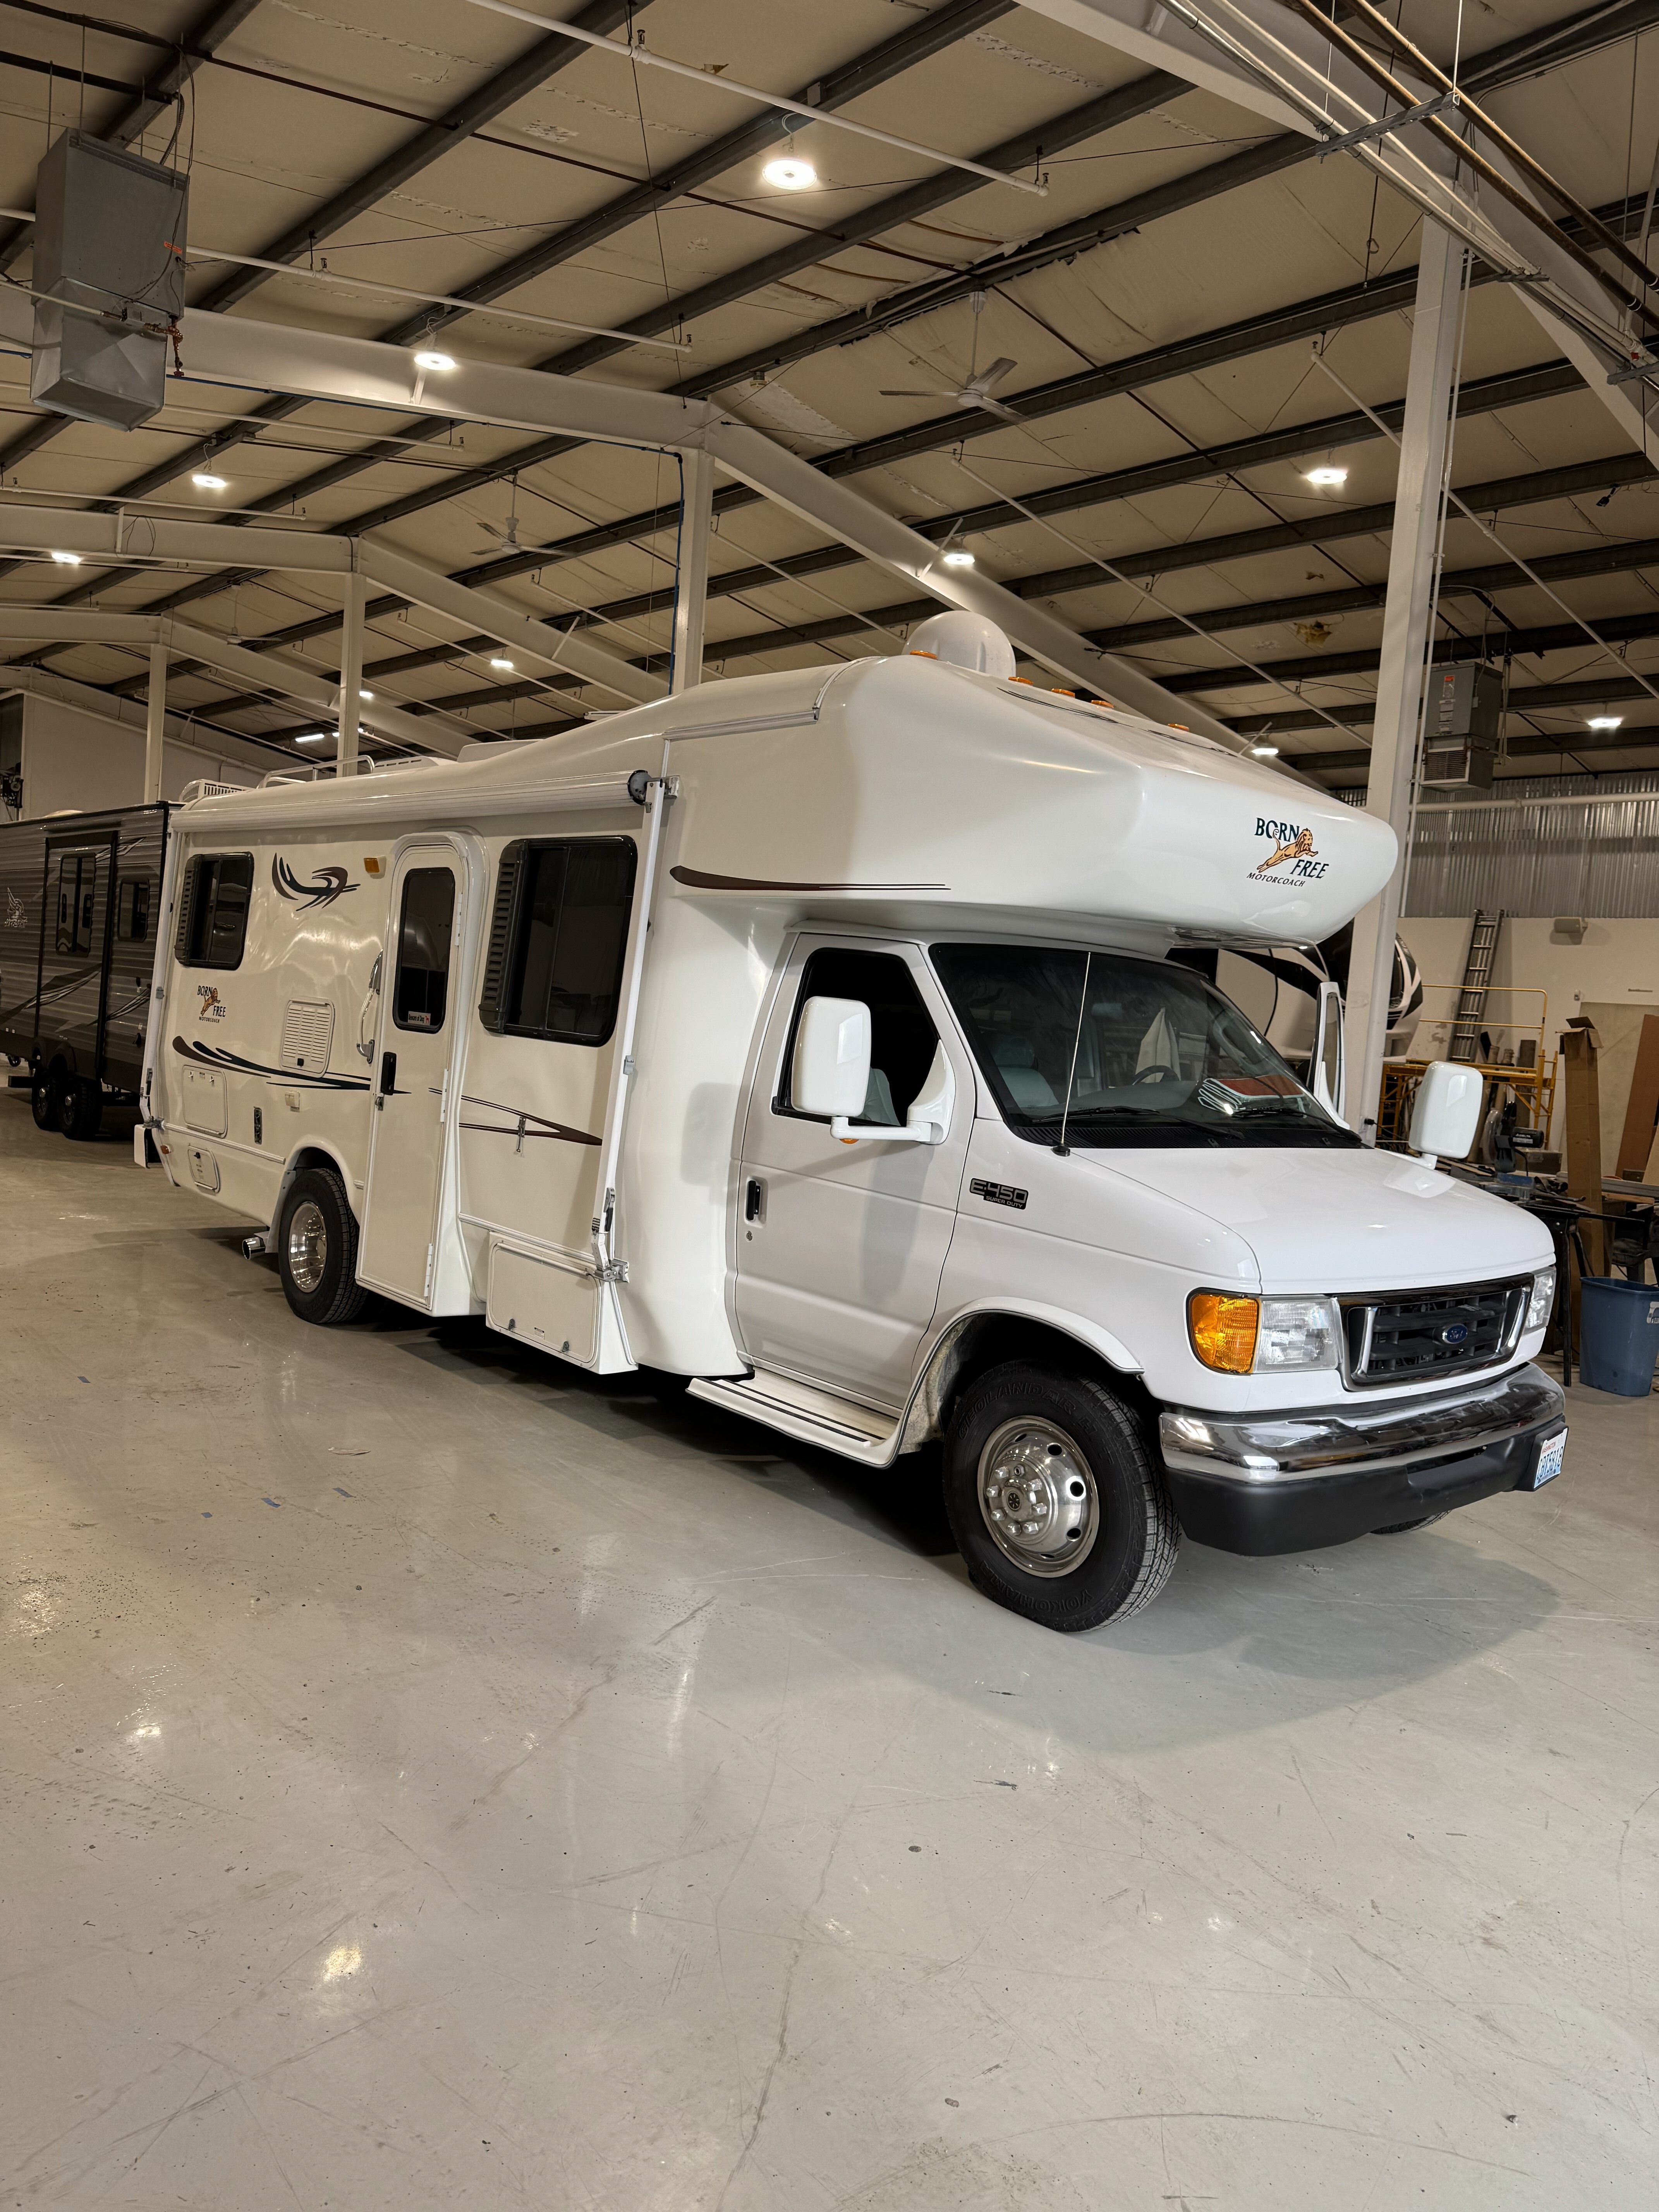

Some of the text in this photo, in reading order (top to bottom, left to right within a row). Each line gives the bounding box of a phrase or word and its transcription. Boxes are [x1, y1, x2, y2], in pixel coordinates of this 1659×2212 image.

[1254, 817, 1300, 842] BORN
[1247, 872, 1305, 887] MOTORCOACH
[1290, 859, 1329, 879] FREE
[198, 986, 213, 996] BORN
[213, 1005, 226, 1017] FREE
[970, 1179, 1028, 1204] E-450
[986, 1196, 1005, 1204] SUPER
[959, 1382, 1075, 1439] GEOLANDAR
[1537, 1446, 1563, 1480] CBT5818
[980, 1560, 1094, 1613] YOKOHAMA
